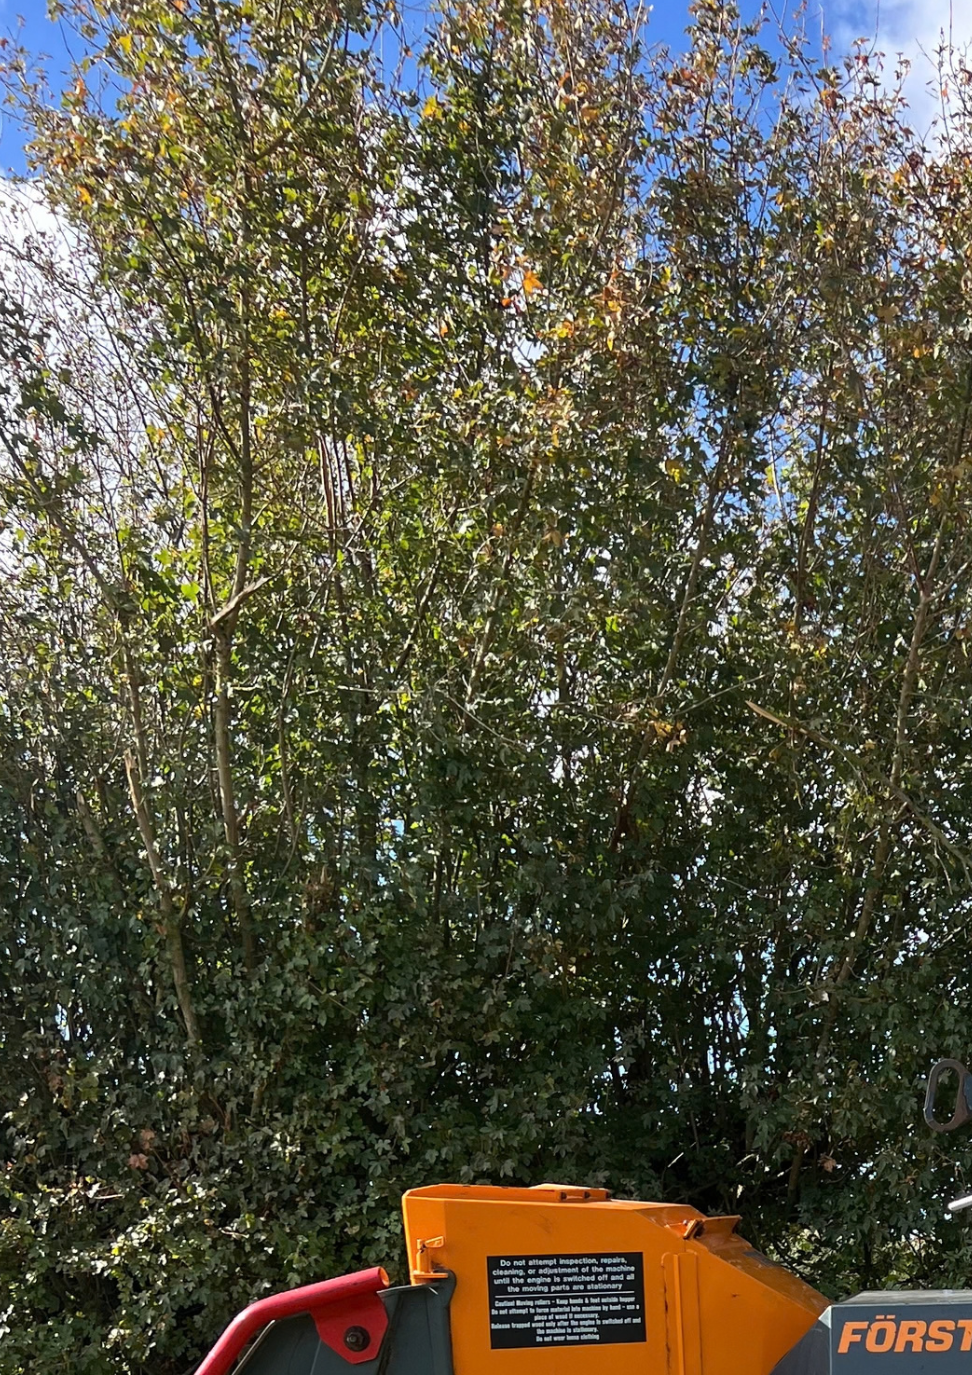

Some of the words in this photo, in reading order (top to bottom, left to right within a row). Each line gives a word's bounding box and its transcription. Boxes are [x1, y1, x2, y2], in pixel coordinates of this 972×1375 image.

[559, 1257, 598, 1265] inspection,
[538, 1267, 579, 1275] adjustment
[527, 1276, 551, 1284] engine
[522, 1285, 549, 1293] moving
[550, 1284, 570, 1292] parts
[587, 1283, 623, 1291] stationary
